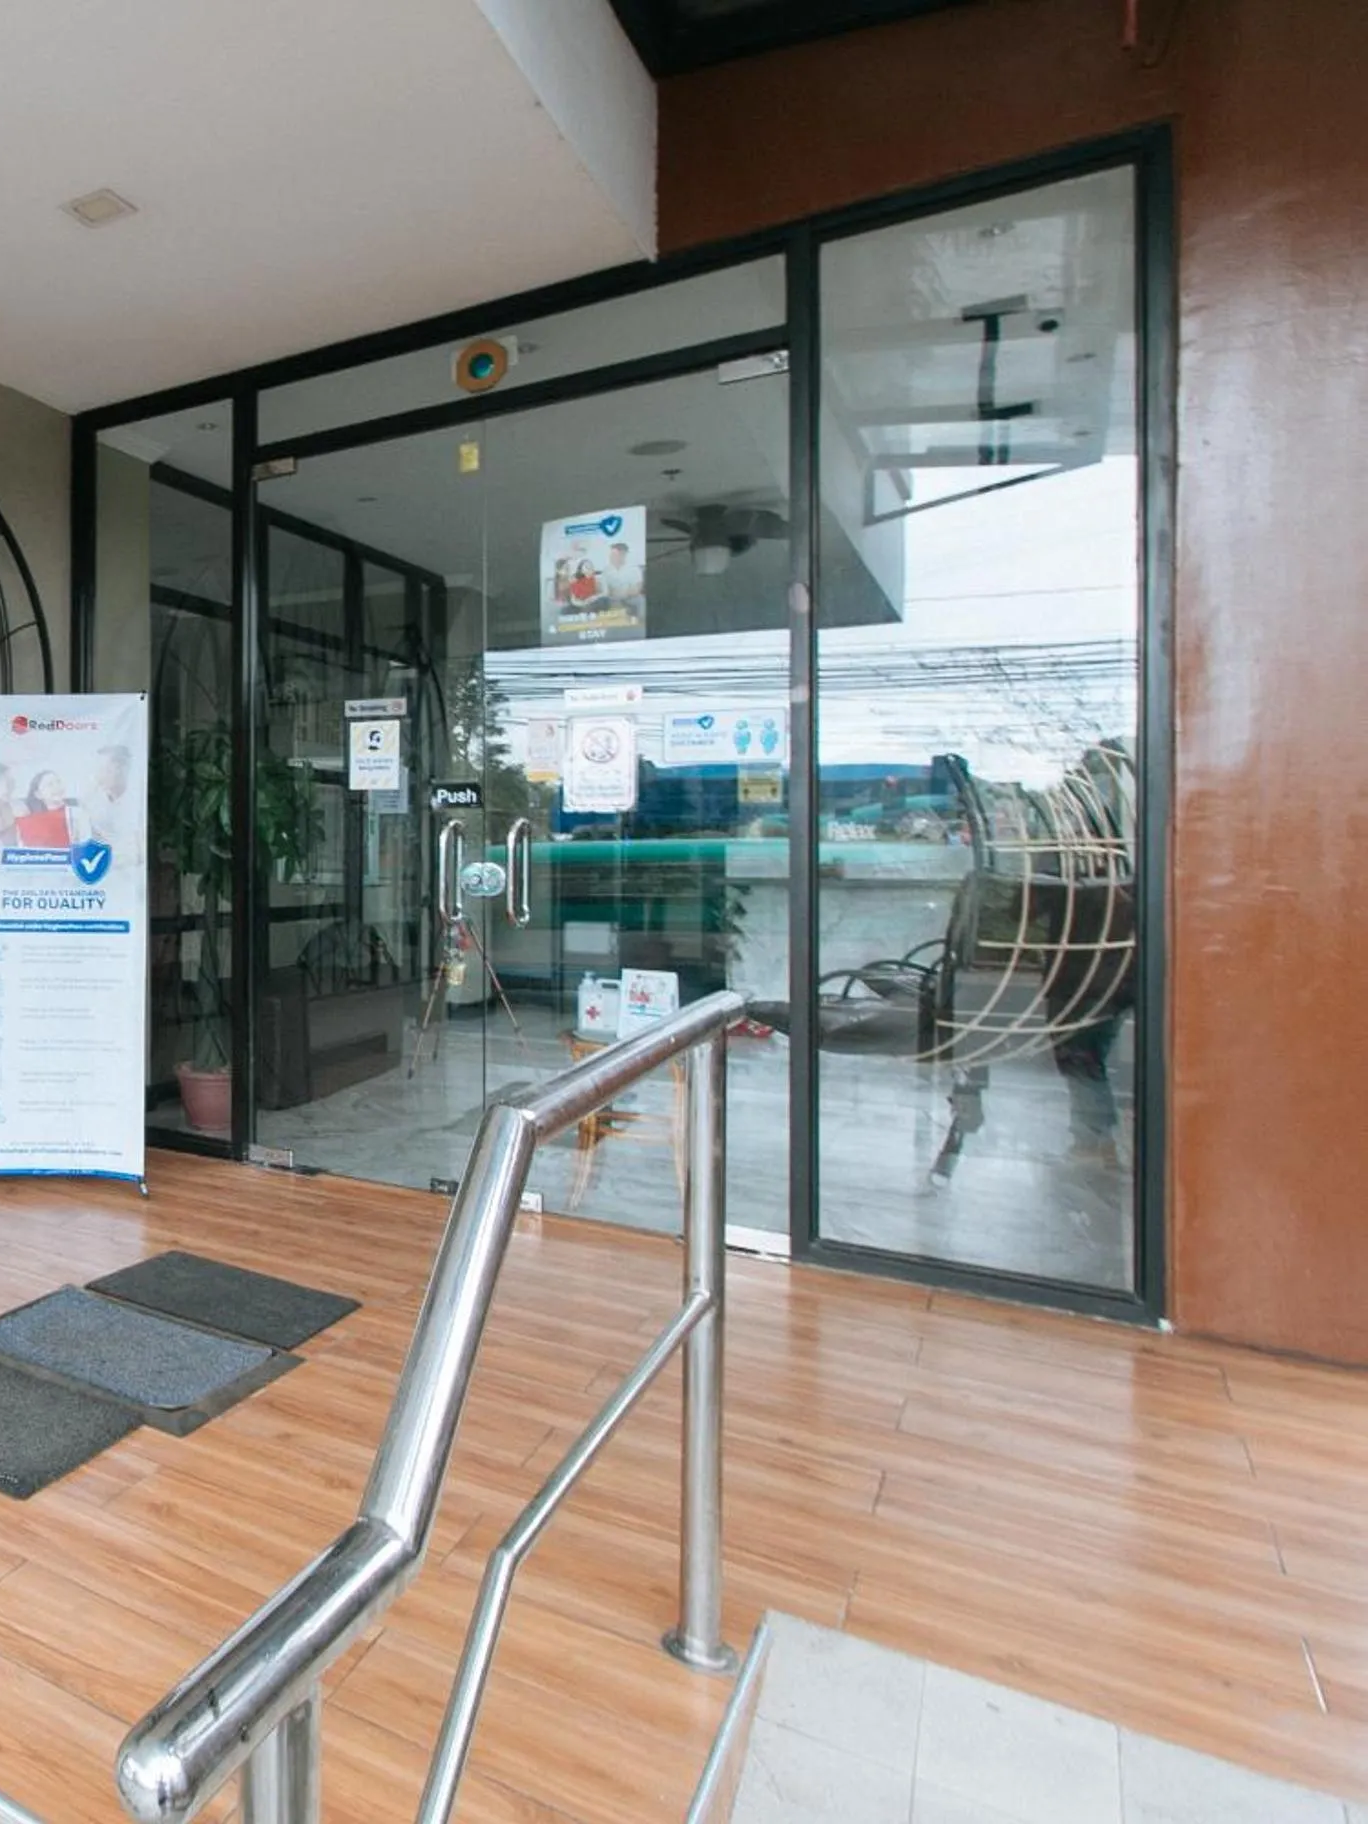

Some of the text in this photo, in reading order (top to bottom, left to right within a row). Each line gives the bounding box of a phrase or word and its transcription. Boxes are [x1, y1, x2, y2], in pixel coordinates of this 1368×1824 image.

[437, 788, 477, 803] Push
[2, 897, 106, 909] FOR QUALITY
